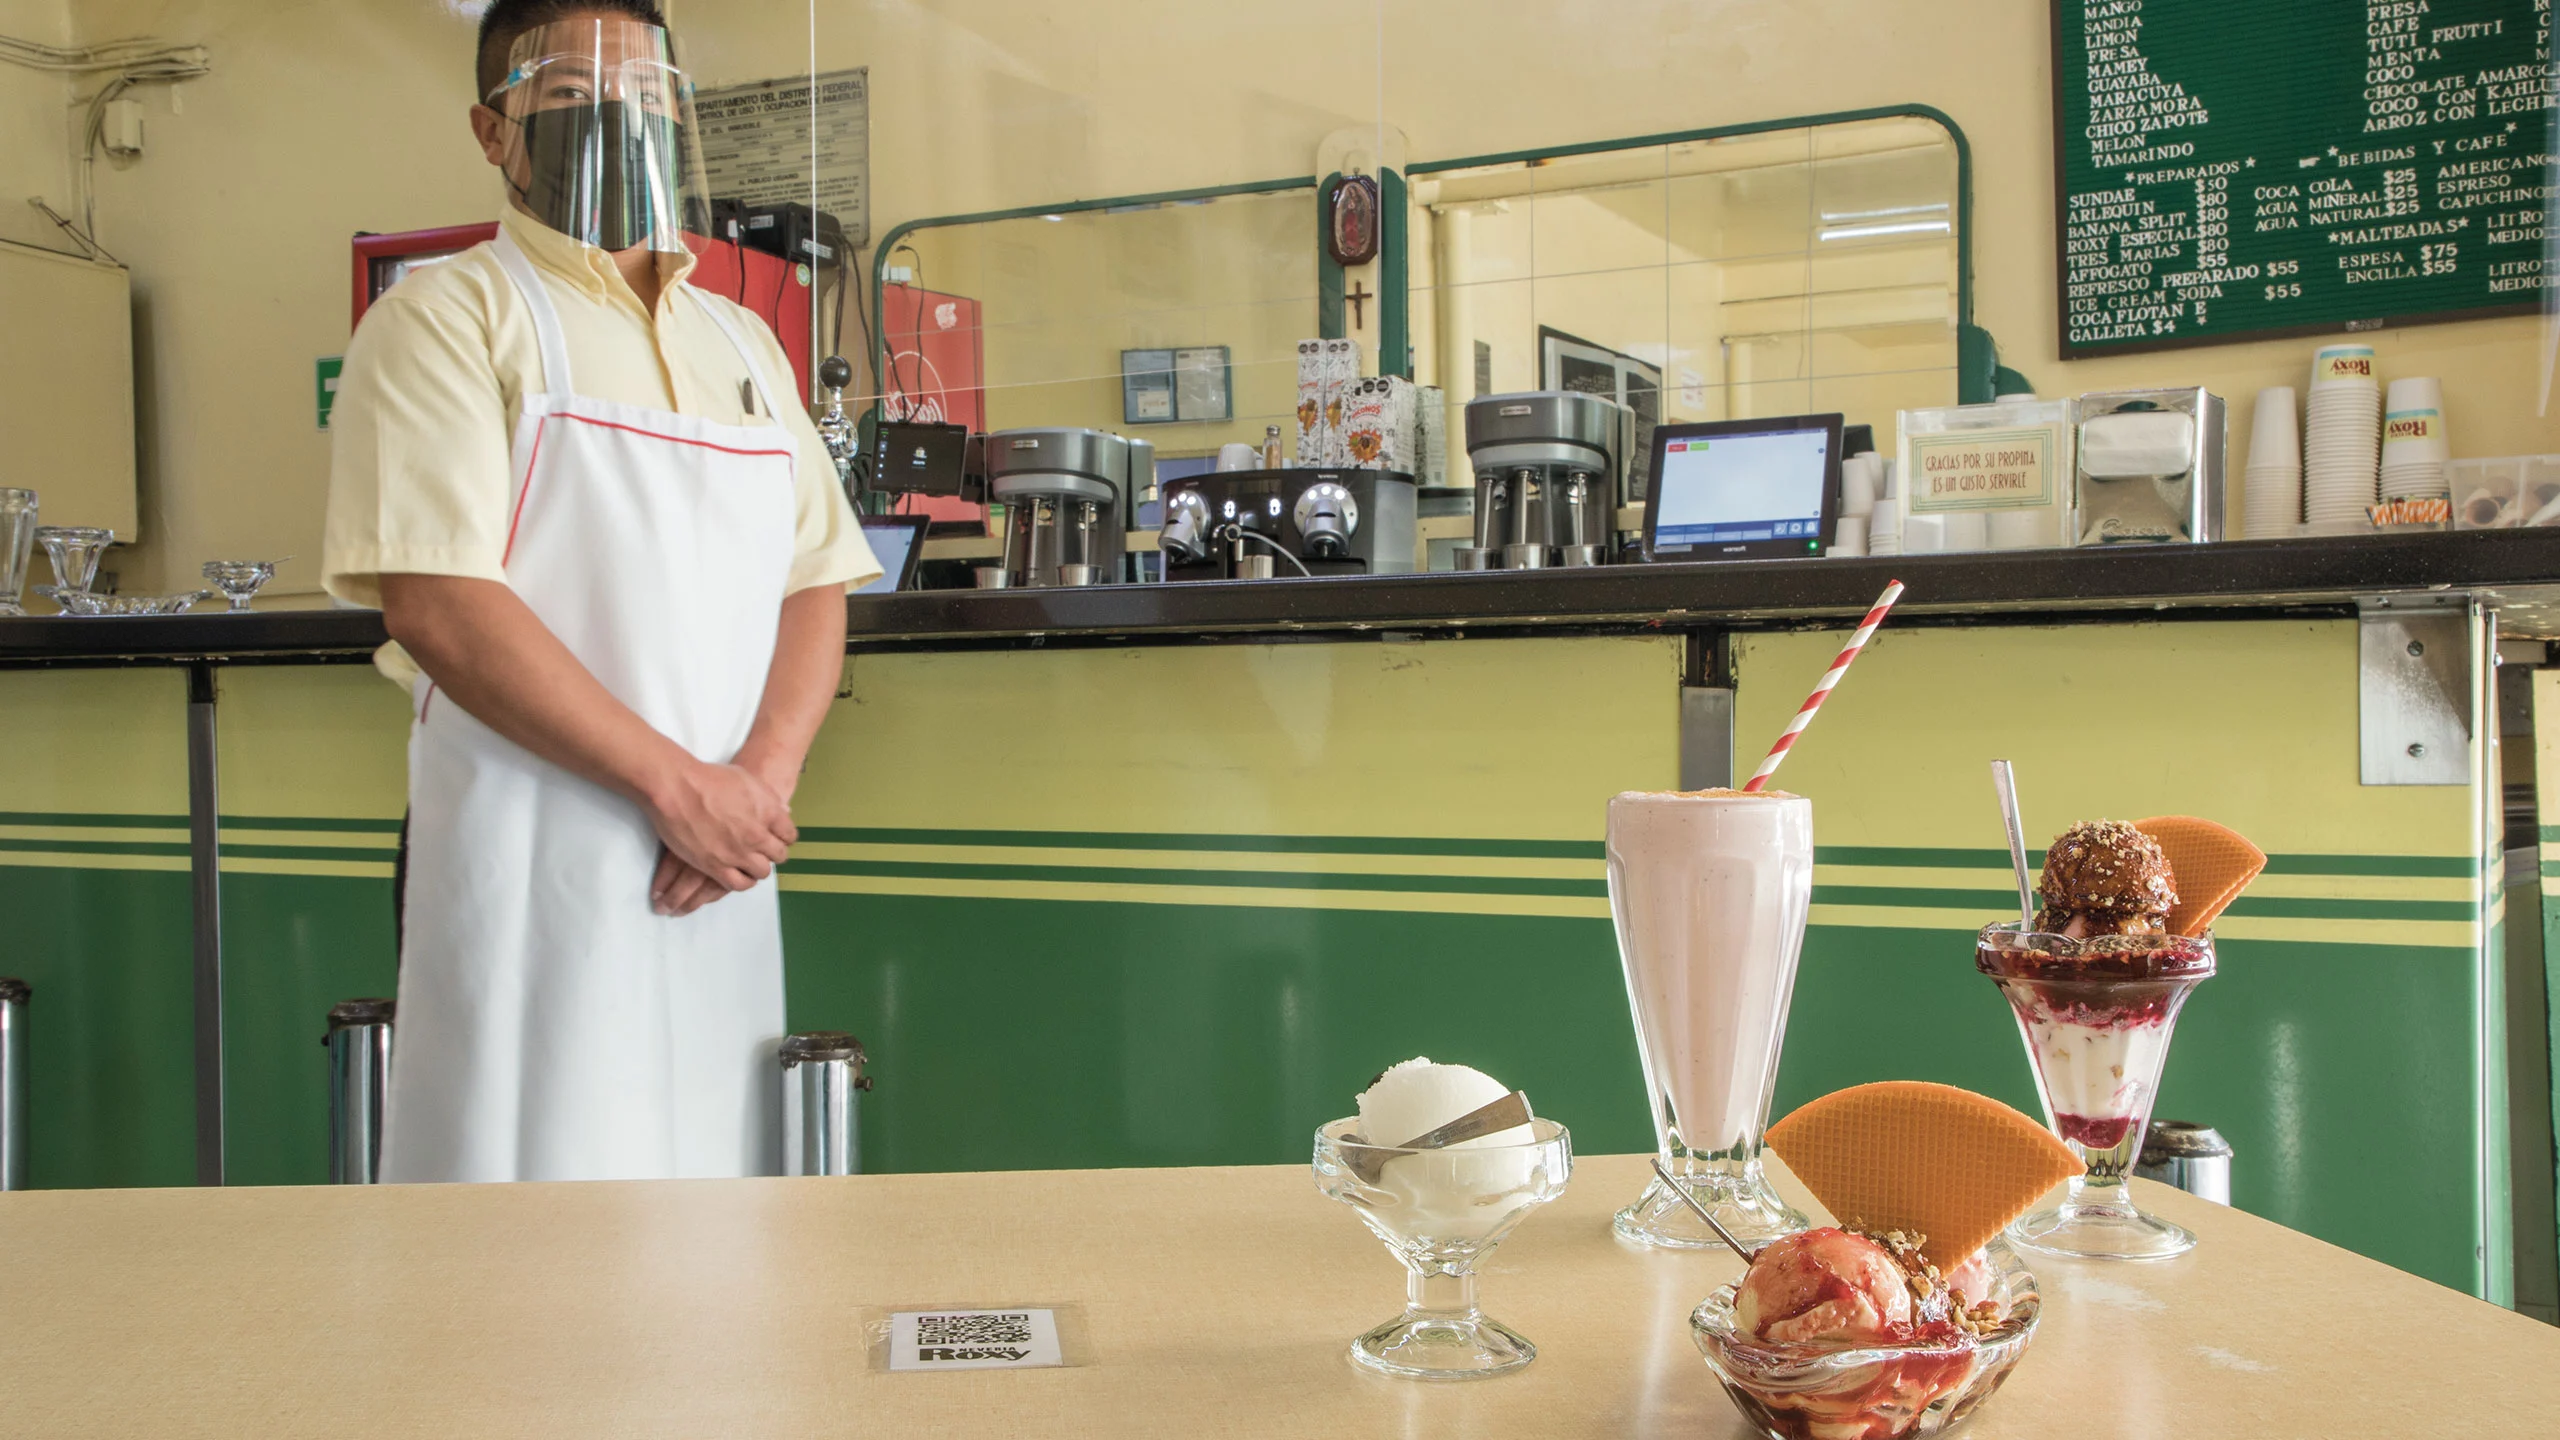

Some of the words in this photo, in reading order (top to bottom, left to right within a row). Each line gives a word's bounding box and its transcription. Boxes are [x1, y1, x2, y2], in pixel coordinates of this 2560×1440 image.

[2084, 0, 2142, 20] MANGO
[2367, 0, 2430, 22] FRESA
[2084, 16, 2143, 34] SANDIA
[2367, 17, 2420, 37] CAFE
[2367, 33, 2417, 52] TUTI
[2431, 20, 2503, 43] FRUTTI
[2085, 29, 2138, 49] LIMON
[2088, 46, 2139, 63] FRESA
[2368, 47, 2441, 69] MENTA
[2087, 57, 2149, 79] MAMEY
[2366, 65, 2414, 84] COCO
[2088, 73, 2161, 93] GUAYABA
[2363, 75, 2466, 100] CHOCOLATE
[2089, 83, 2184, 109] MARACUYA
[2369, 96, 2418, 115] COCO
[2437, 88, 2477, 106] CON
[2090, 96, 2201, 123] ZARZAMORA
[2363, 111, 2427, 133] ARROZ
[2434, 104, 2476, 123] CON
[2085, 120, 2135, 139] CHICO
[2140, 110, 2208, 132] ZAPOTE
[2091, 134, 2146, 153] MELON
[2432, 140, 2445, 155] Y
[2455, 134, 2508, 151] CAFE
[2092, 142, 2194, 168] TAMARINDO
[2254, 185, 2300, 200] COCA
[2309, 178, 2353, 193] COLA
[2383, 168, 2416, 185] $25
[2437, 174, 2511, 194] ESPRESO
[2067, 201, 2155, 224] ARLEQUIN
[2196, 192, 2227, 208] $80
[2069, 188, 2136, 208] SUNDAE
[2255, 201, 2299, 217] AGUA
[2308, 190, 2382, 211] MINERAL
[2384, 184, 2418, 201] $25
[2439, 186, 2545, 210] CAPUCHINO
[2068, 221, 2131, 239] BANANA
[2138, 212, 2186, 230] SPLIT
[2196, 207, 2228, 223] $80
[2255, 216, 2299, 232] AGUA
[2310, 206, 2385, 225] NATURAL
[2386, 200, 2420, 217] $25
[2487, 211, 2543, 229] LITRO
[2067, 236, 2110, 253] ROXY
[2120, 226, 2196, 247] ESPECIAL
[2197, 222, 2228, 239] $80
[2488, 226, 2544, 245] MEDIO
[2066, 252, 2109, 269] TRES
[2120, 243, 2180, 262] MARIAS
[2197, 237, 2229, 254] $80
[2339, 251, 2404, 269] ESPESA
[2421, 242, 2458, 261] $75
[2067, 261, 2152, 283] AFFOGATO
[2197, 253, 2228, 269] $55
[2068, 277, 2150, 298] REFRESCO
[2162, 264, 2259, 288] PREPARADO
[2267, 260, 2299, 278] $55
[2346, 266, 2417, 284] ENCILLA
[2422, 259, 2456, 276] $55
[2489, 259, 2542, 277] LITRO
[2489, 275, 2544, 293] MEDIO
[2069, 298, 2098, 313] ICE
[2107, 290, 2167, 309] CREAM
[2176, 284, 2223, 301] SODA
[2264, 283, 2302, 301] $55
[2069, 311, 2112, 327] COCA
[2069, 323, 2147, 342] GALLETA
[2152, 320, 2176, 335] $4
[1926, 454, 1961, 472] GRACIAS
[1963, 452, 1981, 469] POR
[1985, 451, 1995, 468] SU
[1998, 450, 2036, 467] PROPINA
[1933, 477, 1943, 493] ES
[1946, 476, 1956, 492] UN
[1960, 474, 1986, 491] GUSTO
[1989, 472, 2027, 489] SERVIRLE
[919, 1347, 1031, 1361] Roxy
